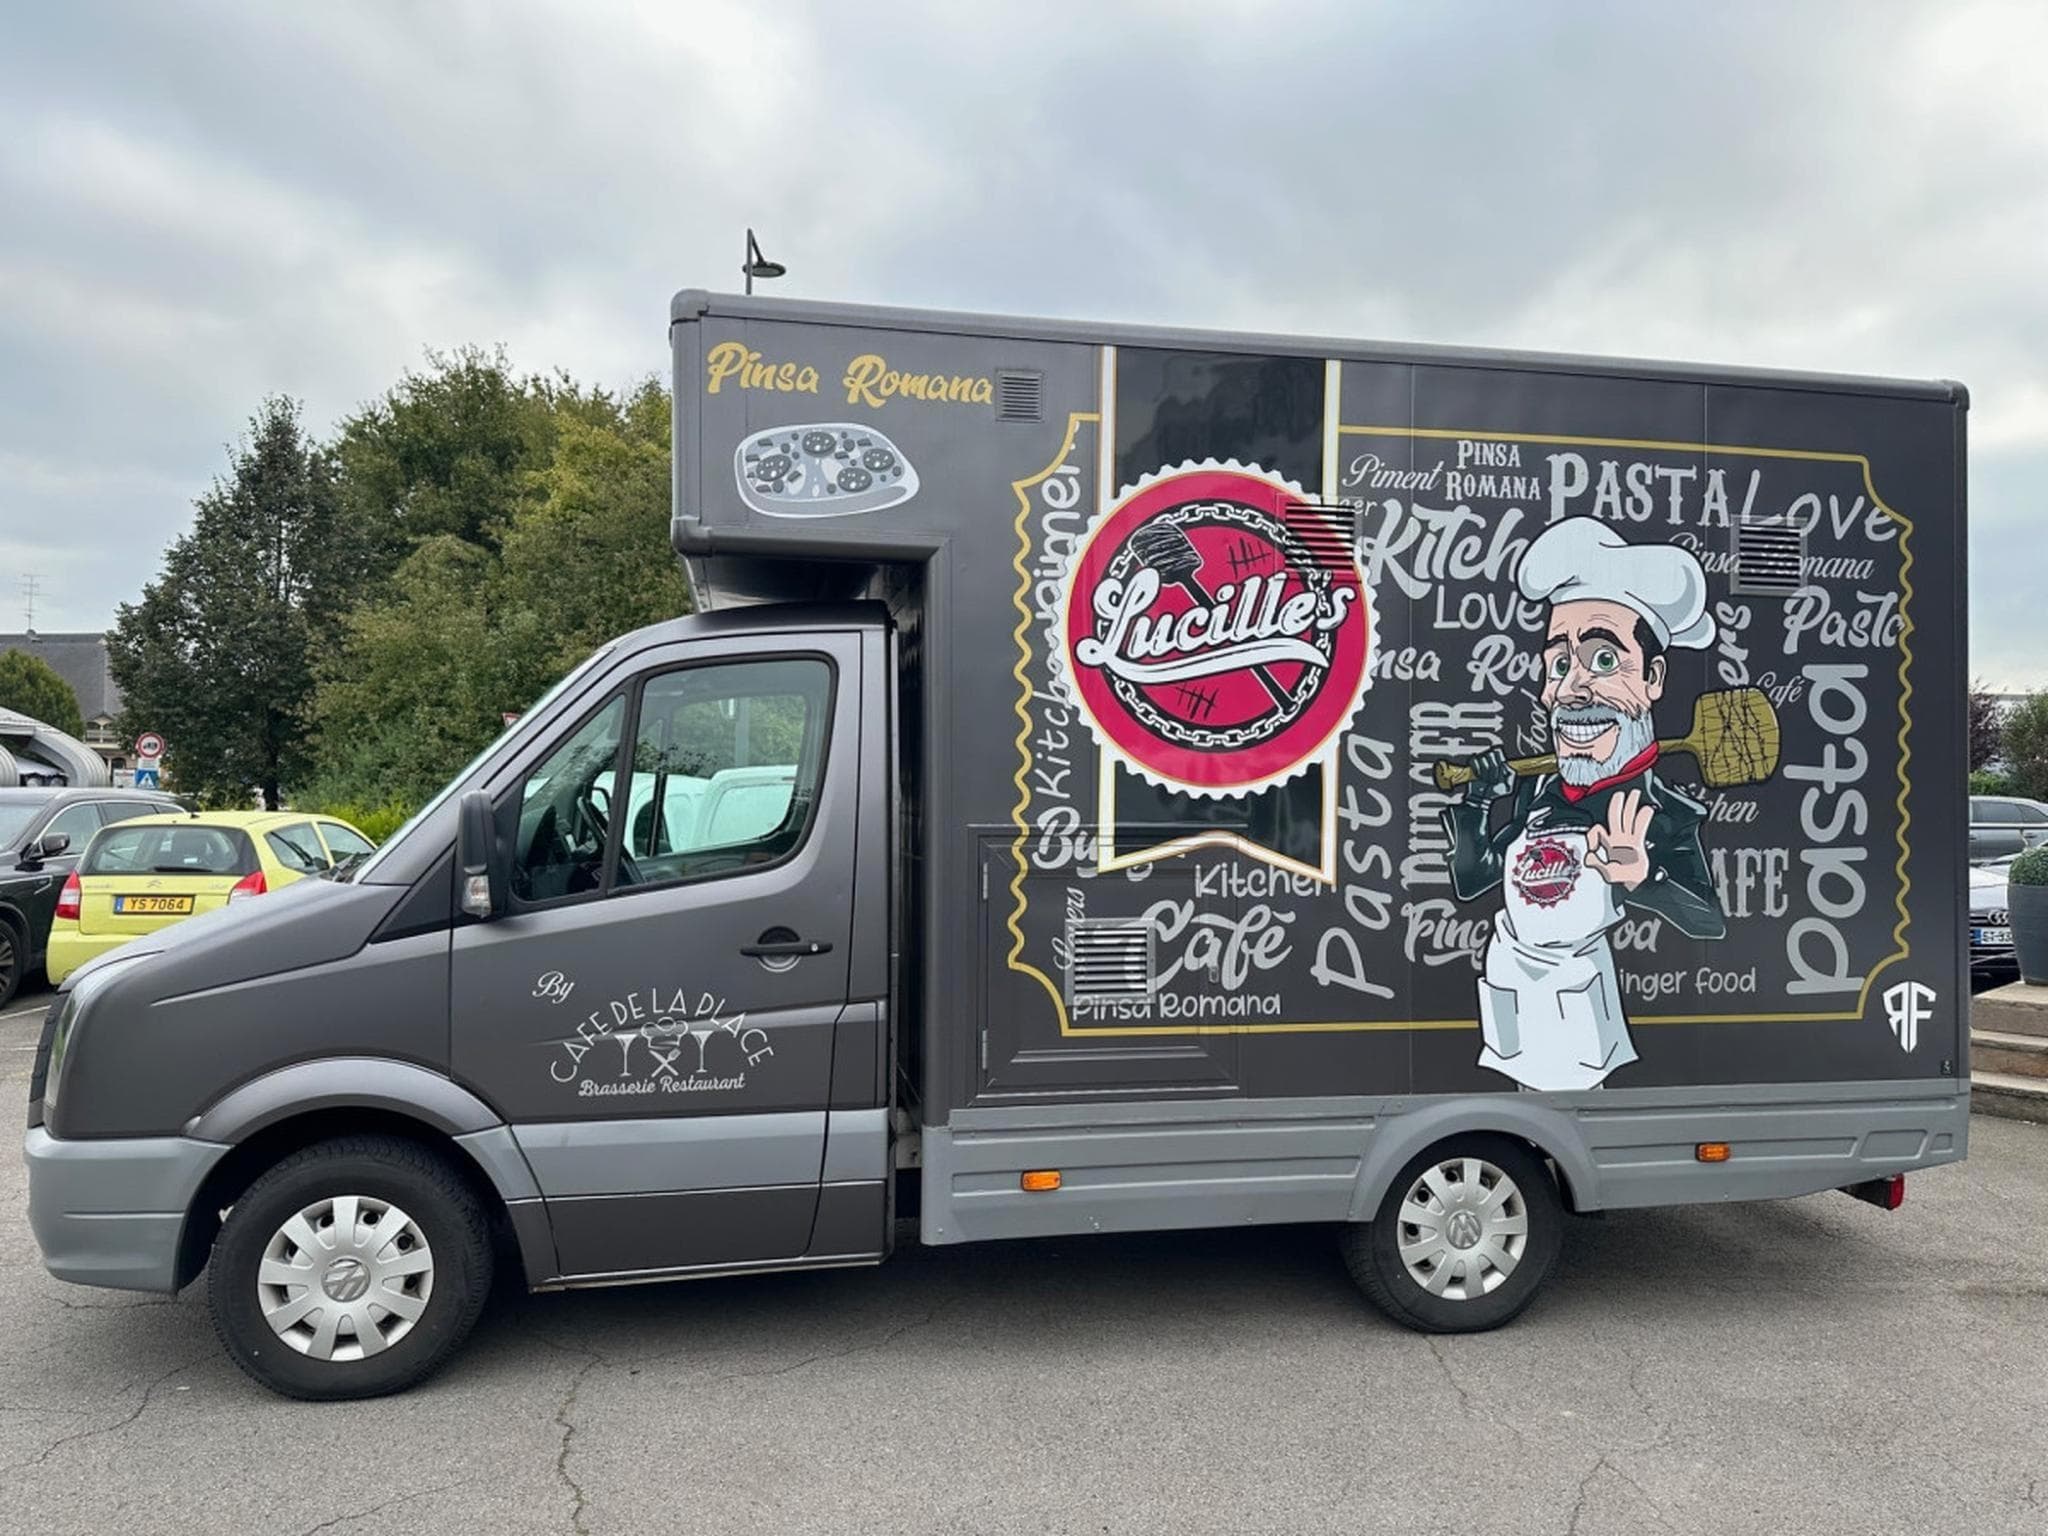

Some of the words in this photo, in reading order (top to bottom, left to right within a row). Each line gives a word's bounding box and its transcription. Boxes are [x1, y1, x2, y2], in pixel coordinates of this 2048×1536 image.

[706, 341, 820, 394] Pinsa
[842, 354, 993, 408] Romana
[1342, 453, 1445, 491] Piment
[1445, 472, 1542, 501] ROMANA
[1457, 440, 1522, 470] PINSA
[1545, 452, 1732, 528] PASTA
[1357, 498, 1530, 600] Kitch
[1783, 664, 1869, 995] pasta
[1310, 733, 1395, 999] Pasta
[1710, 847, 1790, 918] AFE
[1400, 898, 1489, 971] Fing
[532, 970, 575, 1003] By
[1073, 994, 1151, 1021] Pinsa
[1160, 993, 1282, 1019] Romana
[1619, 968, 1687, 1001] inger
[1695, 966, 1757, 995] food
[550, 1011, 612, 1083] CAFE
[610, 992, 645, 1025] DE
[652, 987, 687, 1014] LA
[694, 992, 775, 1067] PLACE
[578, 1078, 656, 1097] Brasserie
[659, 1072, 746, 1093] Restaurant
